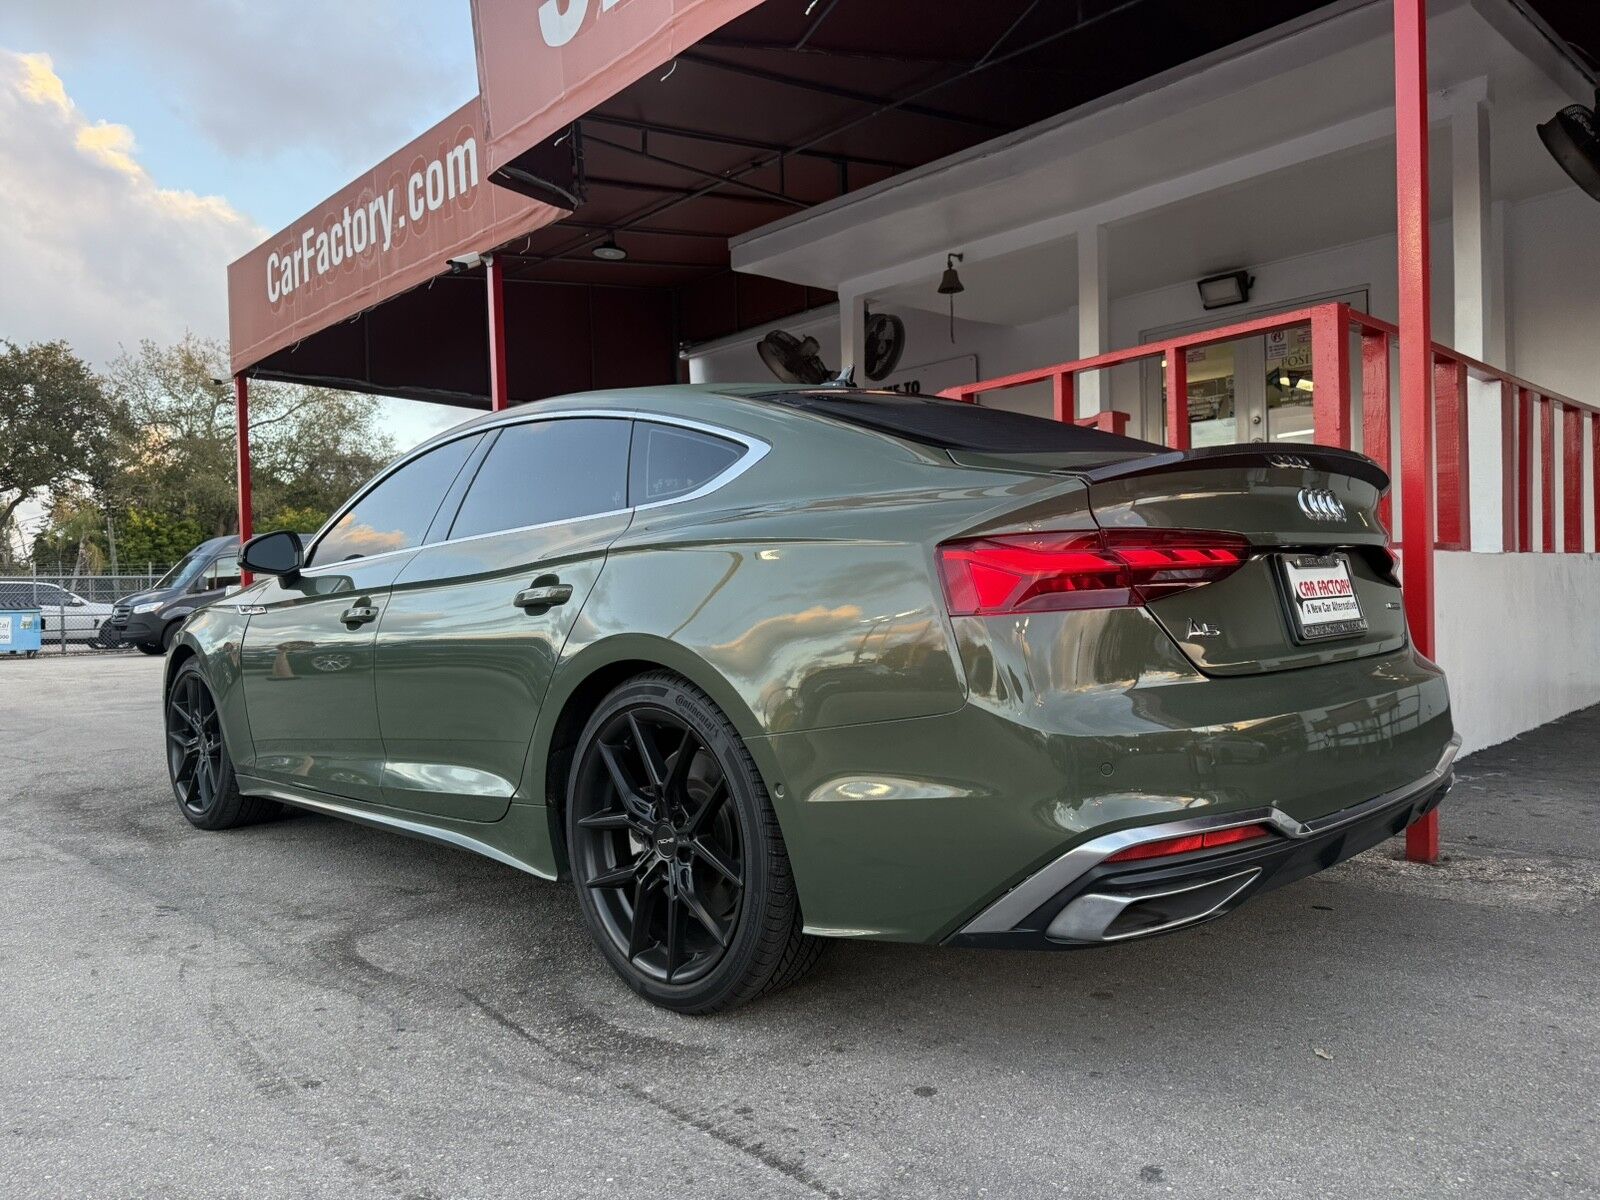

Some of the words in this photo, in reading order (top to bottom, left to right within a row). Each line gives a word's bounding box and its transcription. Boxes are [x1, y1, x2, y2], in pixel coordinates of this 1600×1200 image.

[266, 136, 479, 303] CarFactory.com
[1281, 353, 1311, 368] POSI
[1299, 580, 1316, 597] CAR
[1318, 578, 1351, 596] FACTORY
[1306, 603, 1312, 614] A
[1312, 603, 1321, 614] New
[1322, 602, 1331, 613] Car
[1332, 600, 1358, 612] Alternative
[1185, 617, 1221, 640] A5
[675, 694, 715, 731] Continental
